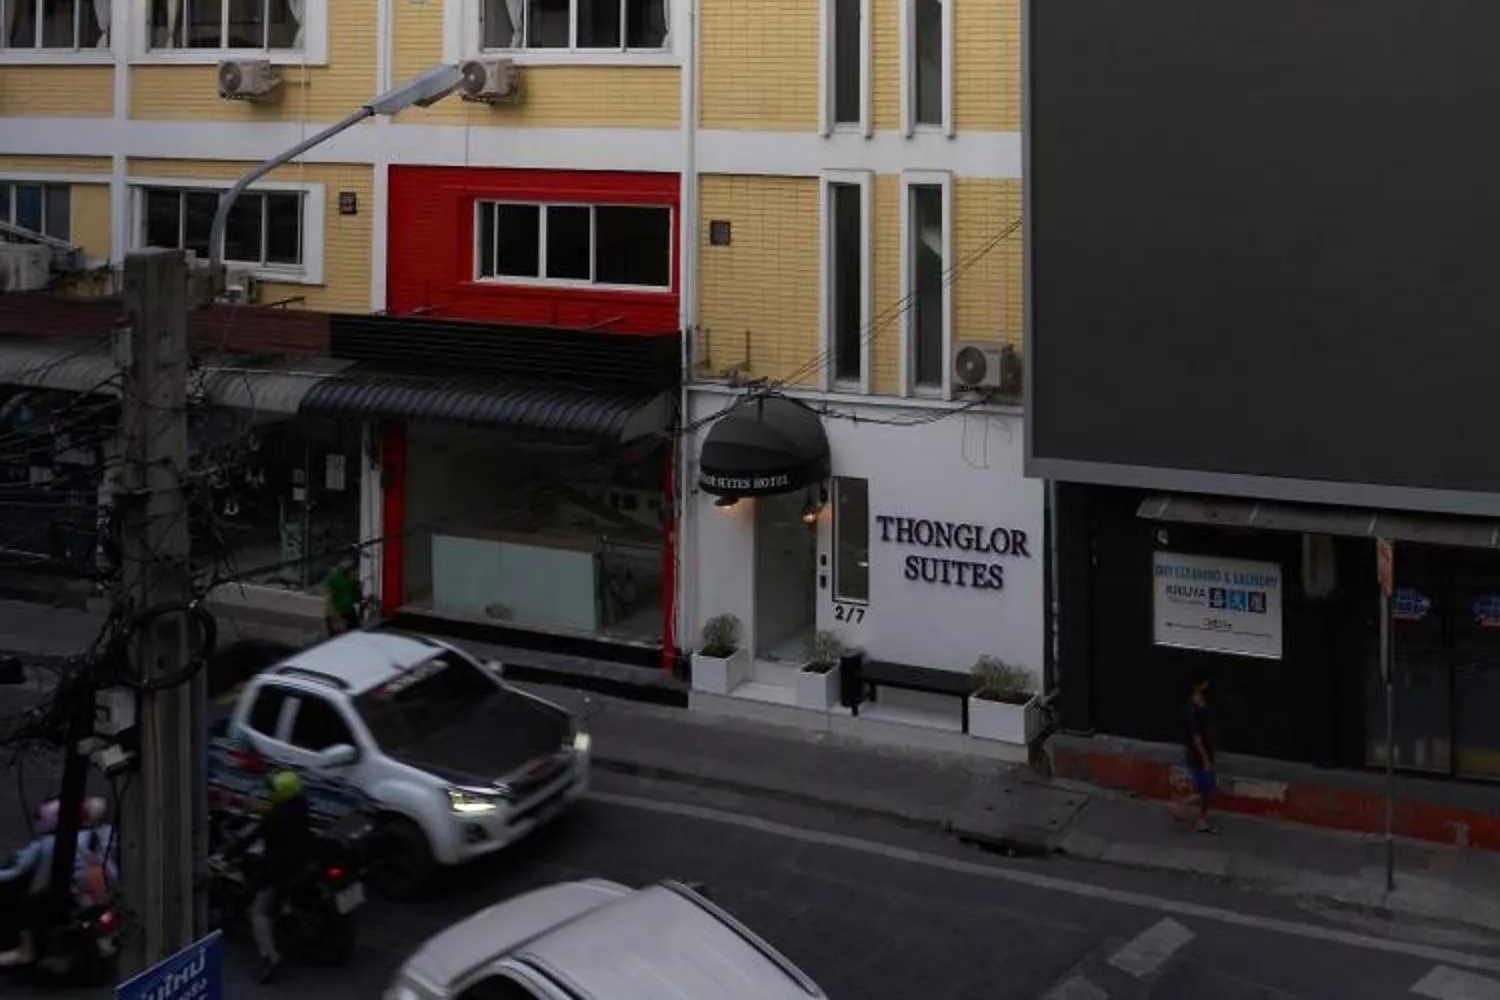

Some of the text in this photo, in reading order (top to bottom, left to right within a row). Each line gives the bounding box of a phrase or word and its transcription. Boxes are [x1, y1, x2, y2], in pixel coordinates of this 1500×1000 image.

[876, 515, 1030, 557] THONGLOR
[905, 555, 1003, 590] SUITES
[835, 605, 865, 624] 2/7
